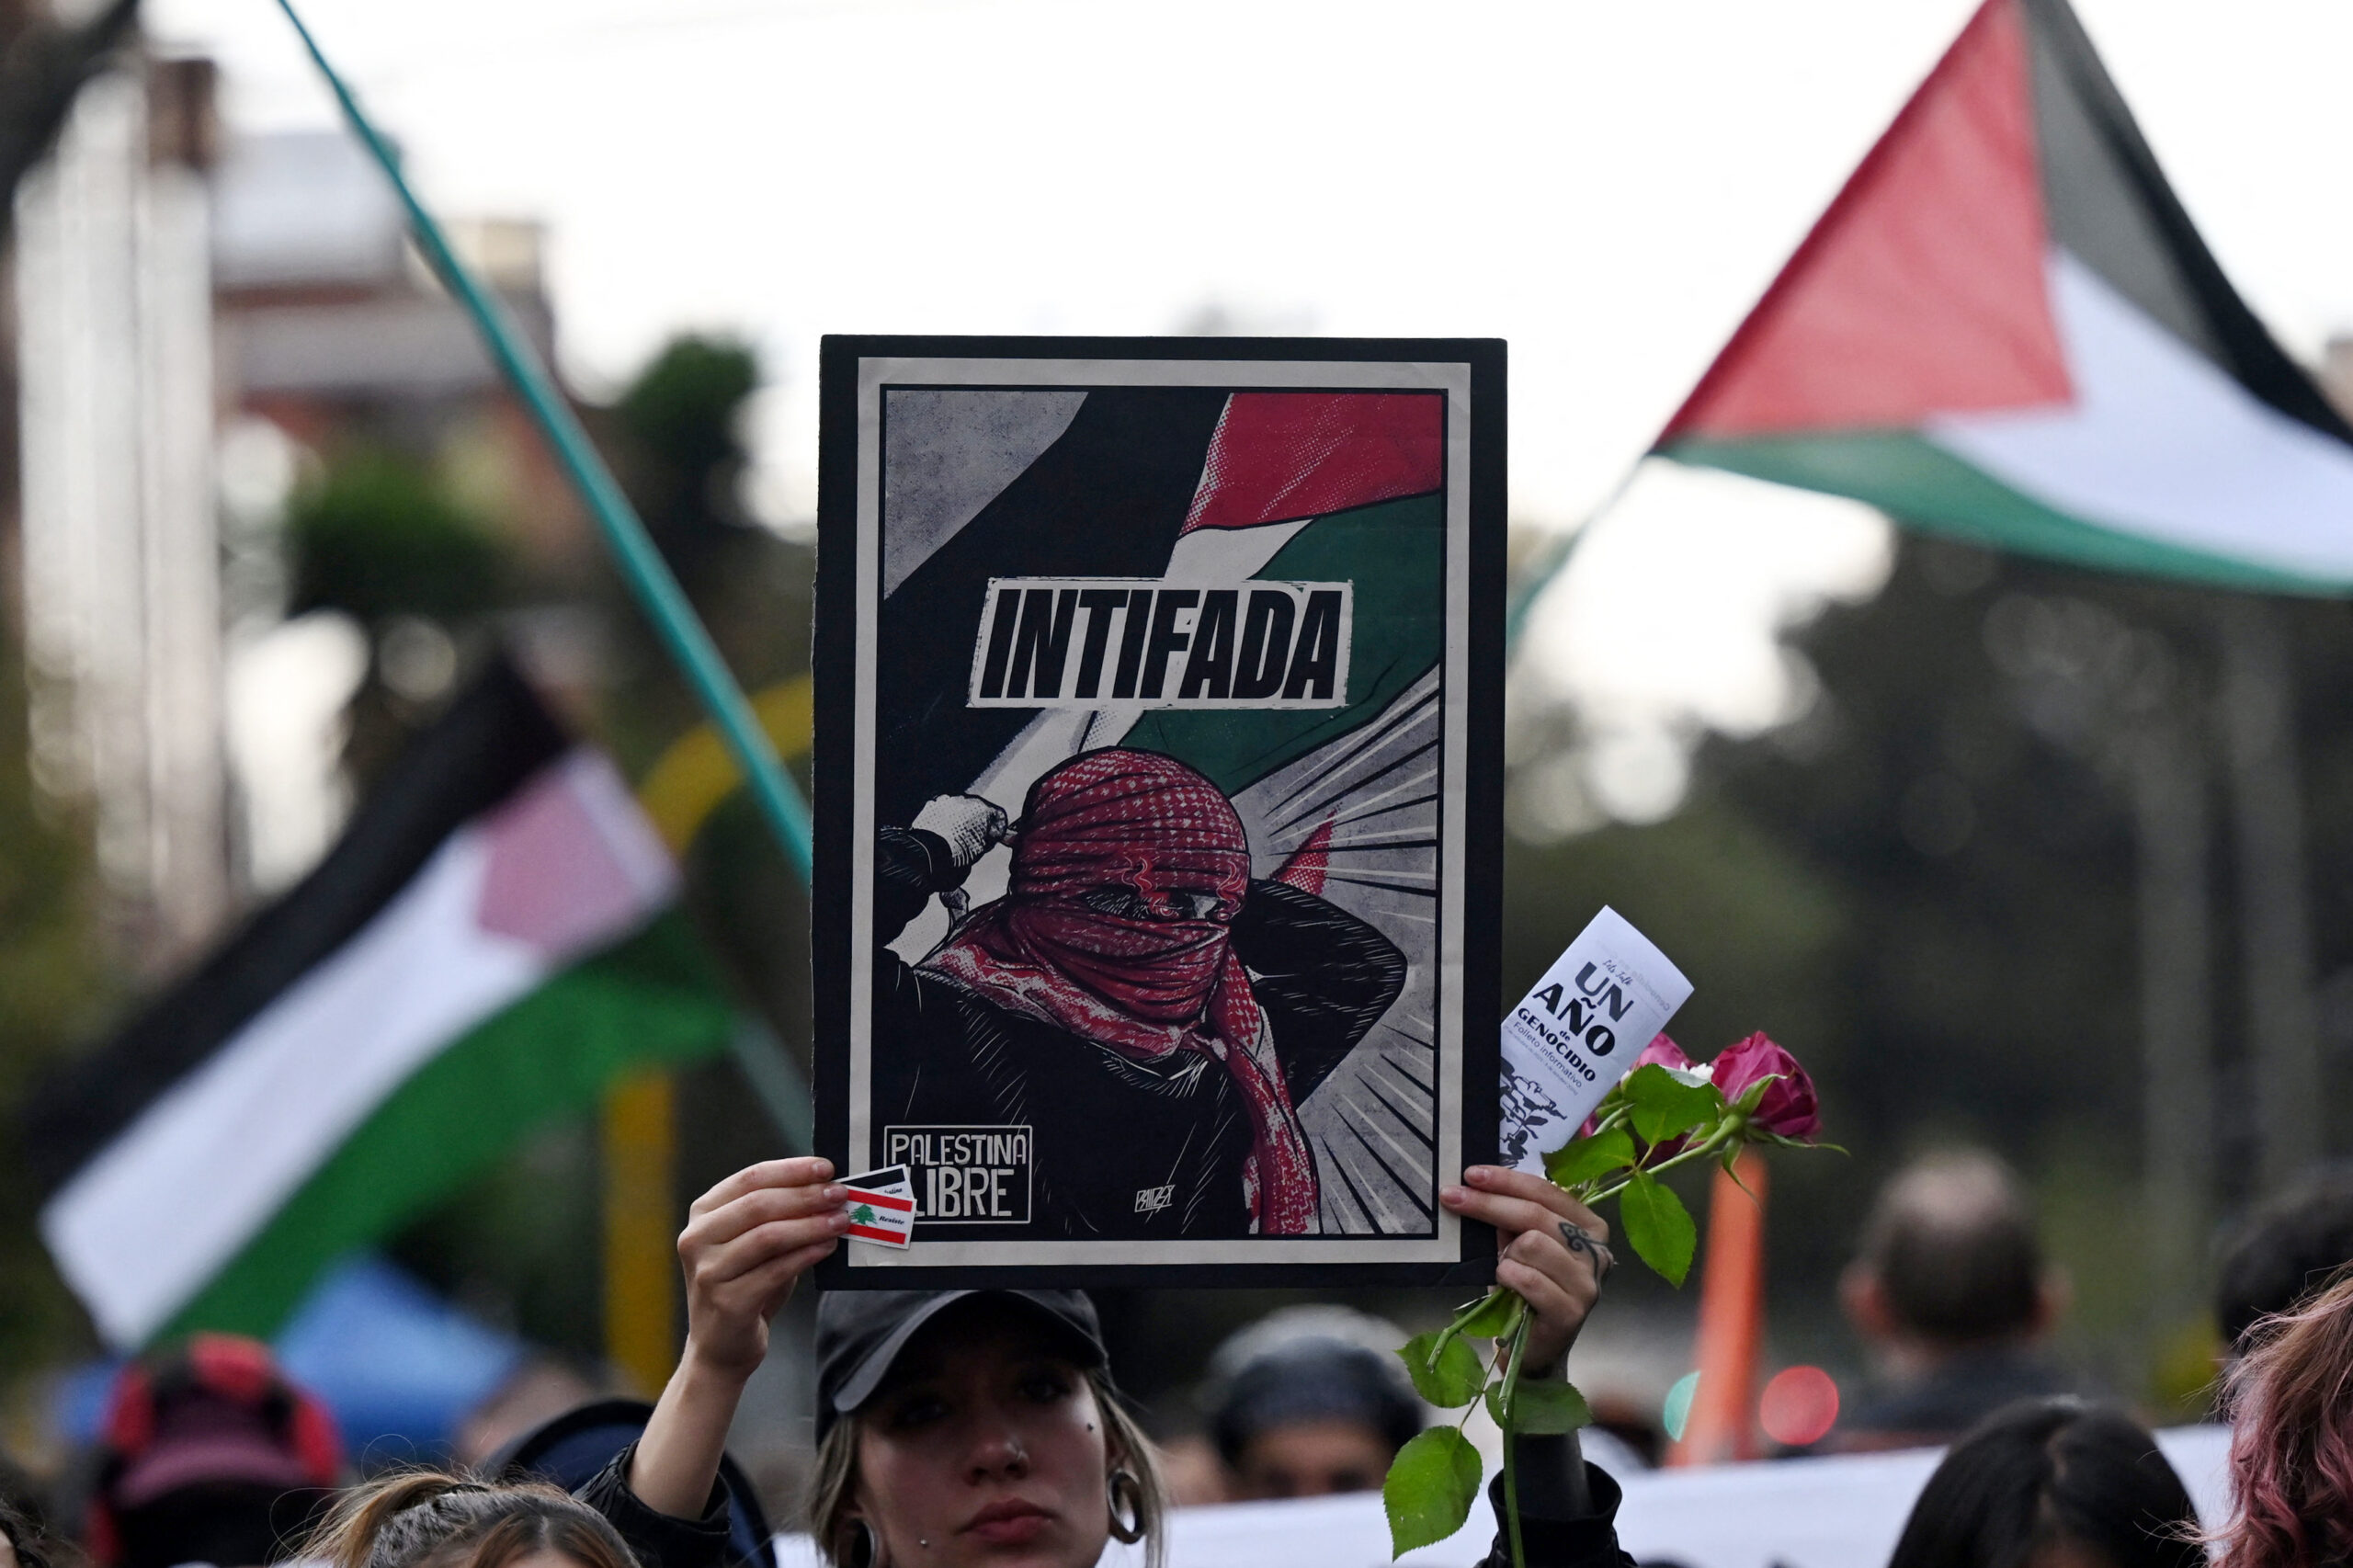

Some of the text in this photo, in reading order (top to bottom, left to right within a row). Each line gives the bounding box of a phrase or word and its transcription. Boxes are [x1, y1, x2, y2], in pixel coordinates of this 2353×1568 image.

[979, 589, 1342, 699] INTIFADA
[1532, 983, 1616, 1057] AÑO
[1575, 961, 1634, 1022] UN
[1513, 1021, 1541, 1048] Folleto
[1540, 1045, 1583, 1088] informativo
[1518, 1007, 1596, 1082] GENOCIDIO
[1559, 1030, 1571, 1041] de
[891, 1133, 1027, 1165] PALESTINA
